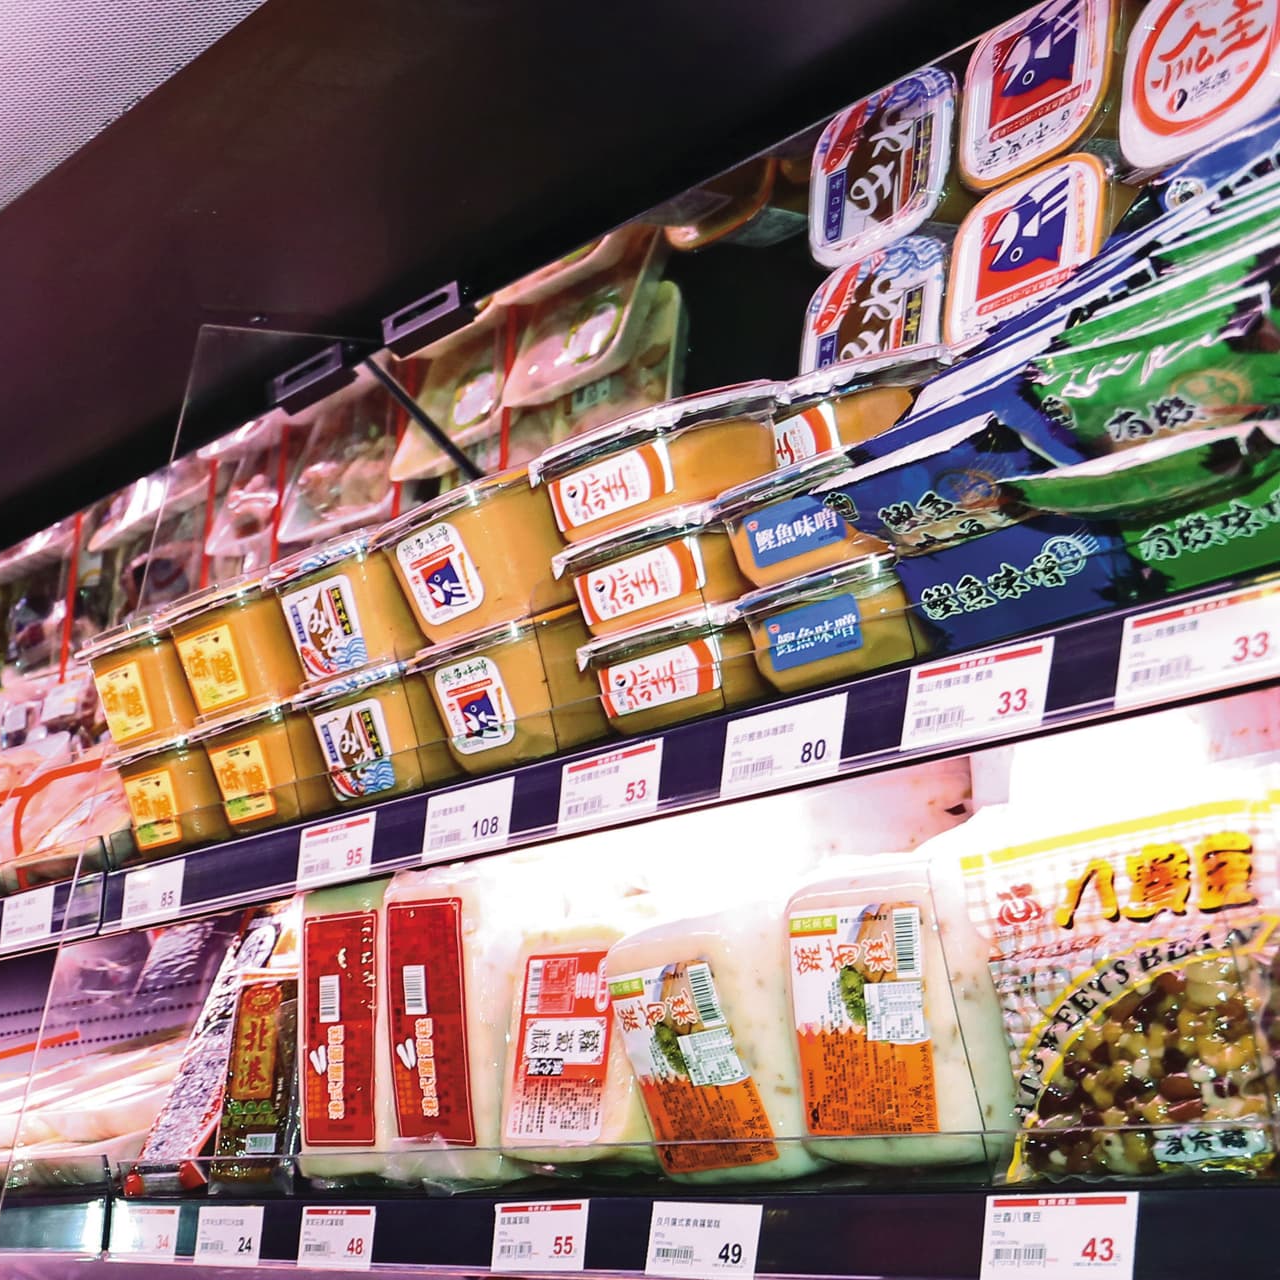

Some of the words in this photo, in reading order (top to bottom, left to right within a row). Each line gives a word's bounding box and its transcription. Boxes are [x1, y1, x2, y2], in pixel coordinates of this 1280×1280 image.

[755, 510, 838, 553] 鰹魚味噌
[307, 608, 343, 657] みそ
[1231, 630, 1270, 664] 33
[997, 687, 1028, 716] 33
[800, 738, 827, 765] 80
[624, 778, 648, 803] 53
[471, 815, 500, 840] 108
[345, 847, 363, 867] 95
[1055, 831, 1258, 930] 八寶豆
[238, 1017, 270, 1092] 北港
[154, 1234, 171, 1251] 34
[238, 1236, 252, 1253] 24
[346, 1237, 364, 1255] 48
[553, 1235, 574, 1255] 55
[718, 1242, 743, 1264] 49
[1081, 1237, 1114, 1262] 43
